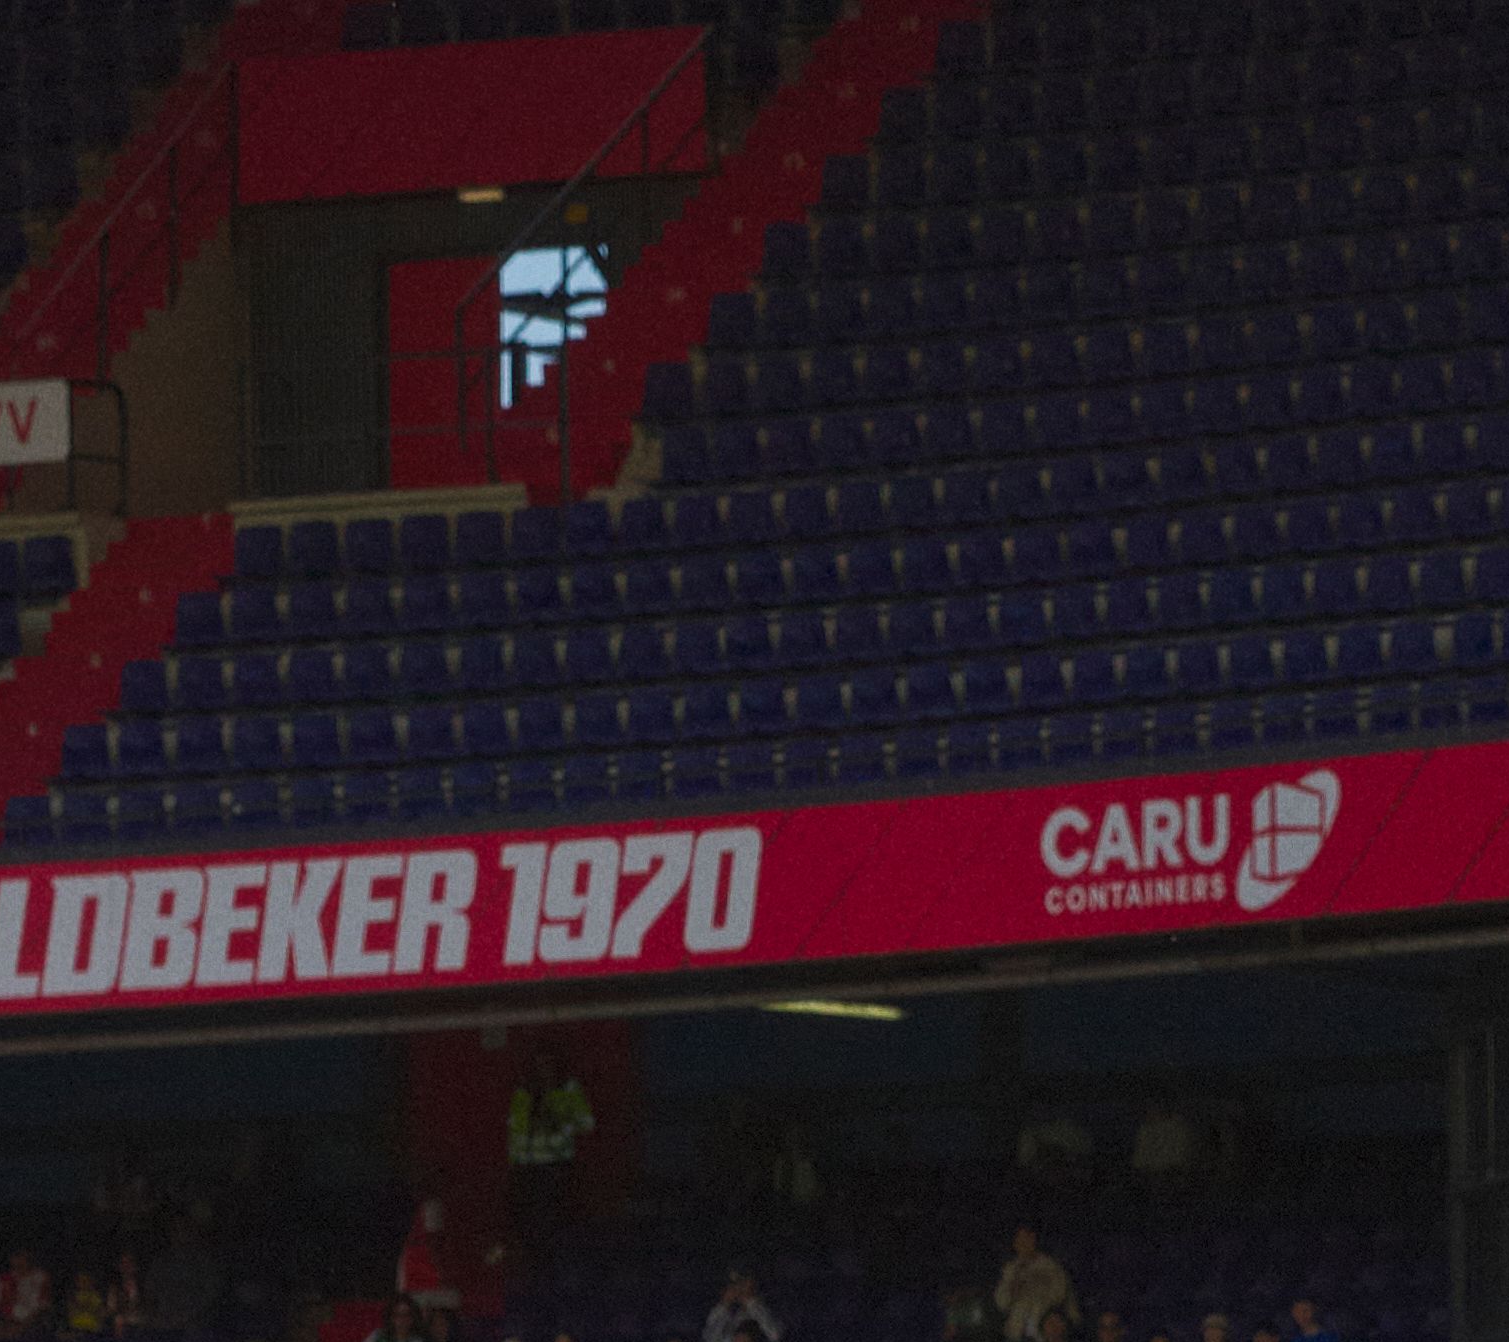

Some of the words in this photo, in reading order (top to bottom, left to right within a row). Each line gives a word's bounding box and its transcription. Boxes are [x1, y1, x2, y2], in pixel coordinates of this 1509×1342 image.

[1039, 795, 1231, 879] CARU
[498, 826, 763, 968] 1970
[1044, 871, 1227, 916] CONTAINERS
